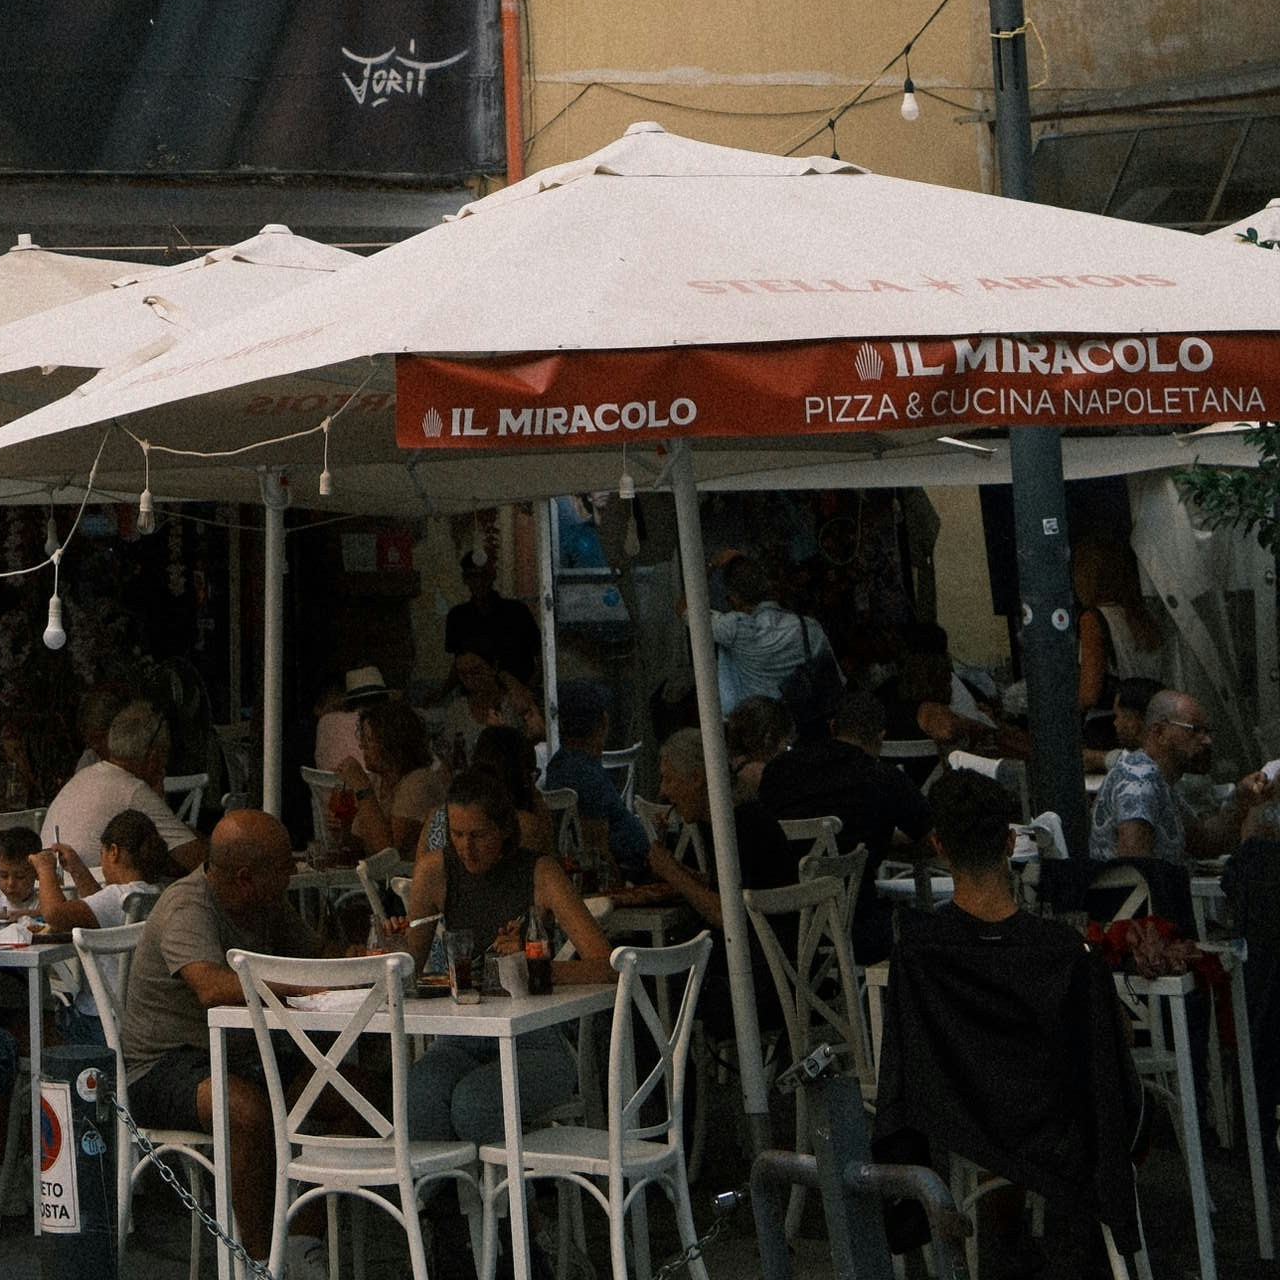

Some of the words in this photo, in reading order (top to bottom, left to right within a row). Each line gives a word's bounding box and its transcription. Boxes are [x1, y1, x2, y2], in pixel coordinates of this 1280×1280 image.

[686, 279, 918, 295] STELLA
[977, 274, 1177, 291] ARTOIS
[889, 341, 944, 377] IL
[952, 336, 1213, 375] MIRACOLO
[451, 407, 487, 436] IL
[497, 399, 697, 436] MIRACOLO
[804, 393, 898, 424] PIZZA
[905, 391, 924, 419] &
[929, 389, 1055, 417] CUCINA
[1063, 386, 1266, 416] NAPOLETANA
[40, 1181, 63, 1198] ETO
[40, 1202, 70, 1219] OSTA
